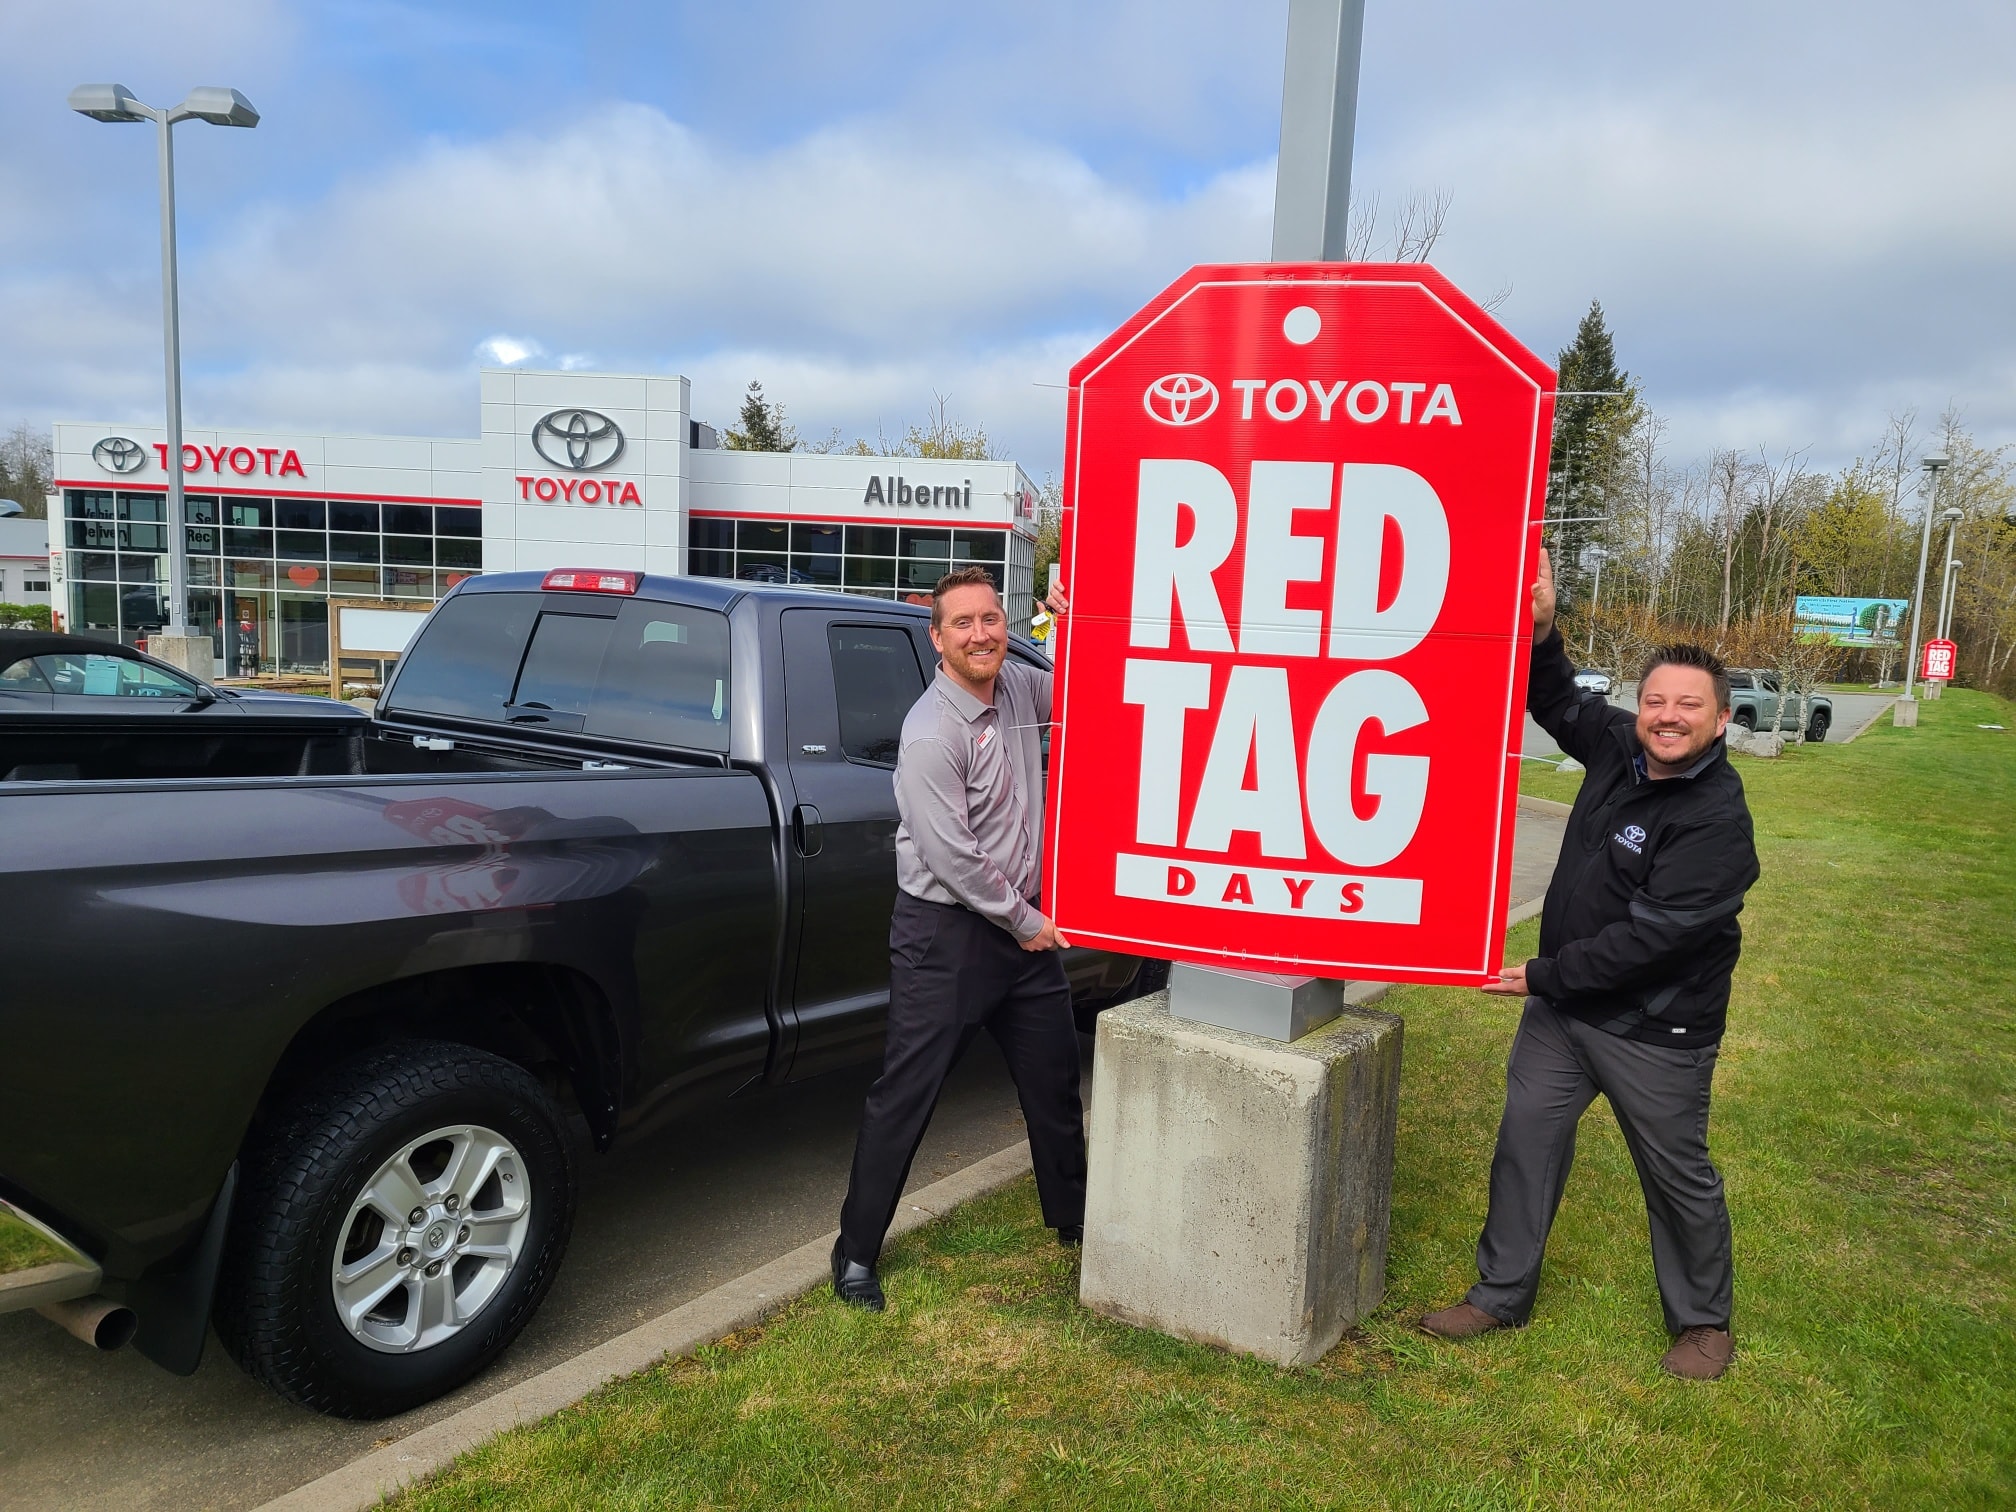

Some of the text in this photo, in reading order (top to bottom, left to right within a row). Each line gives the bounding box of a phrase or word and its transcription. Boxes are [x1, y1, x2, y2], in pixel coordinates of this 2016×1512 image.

[1232, 378, 1463, 425] TOYOTA
[152, 442, 307, 478] TOYOTA
[515, 476, 643, 506] TOYOTA
[864, 475, 971, 508] Alberni
[85, 508, 127, 520] Vehice
[1130, 458, 1451, 660] RED
[1927, 660, 1950, 673] TAG
[1929, 649, 1951, 661] RED
[1123, 658, 1431, 867] TAG
[1613, 833, 1642, 855] TOYOTA
[1166, 865, 1365, 914] DAYS
